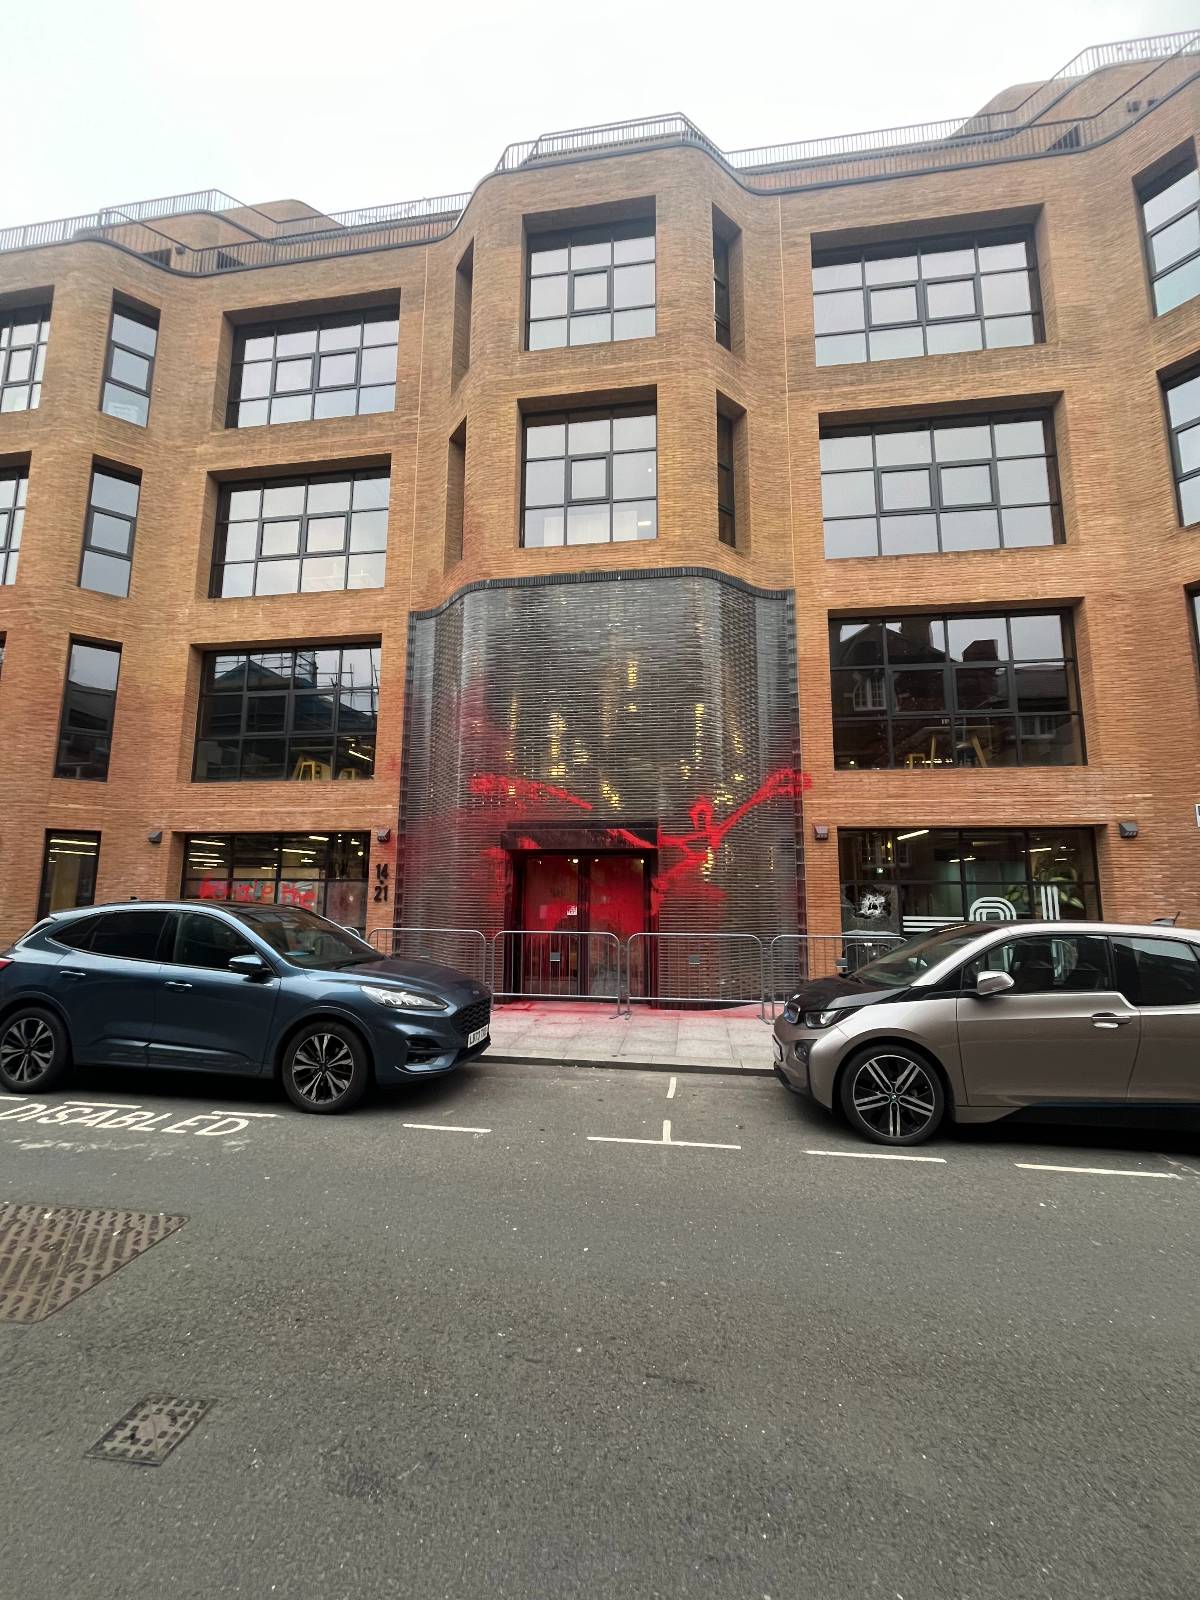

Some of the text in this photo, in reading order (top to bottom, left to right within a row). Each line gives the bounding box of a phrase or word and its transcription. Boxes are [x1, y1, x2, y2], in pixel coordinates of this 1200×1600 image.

[376, 864, 389, 879] 14
[374, 885, 388, 903] 21
[0, 1103, 249, 1136] DISABLED
